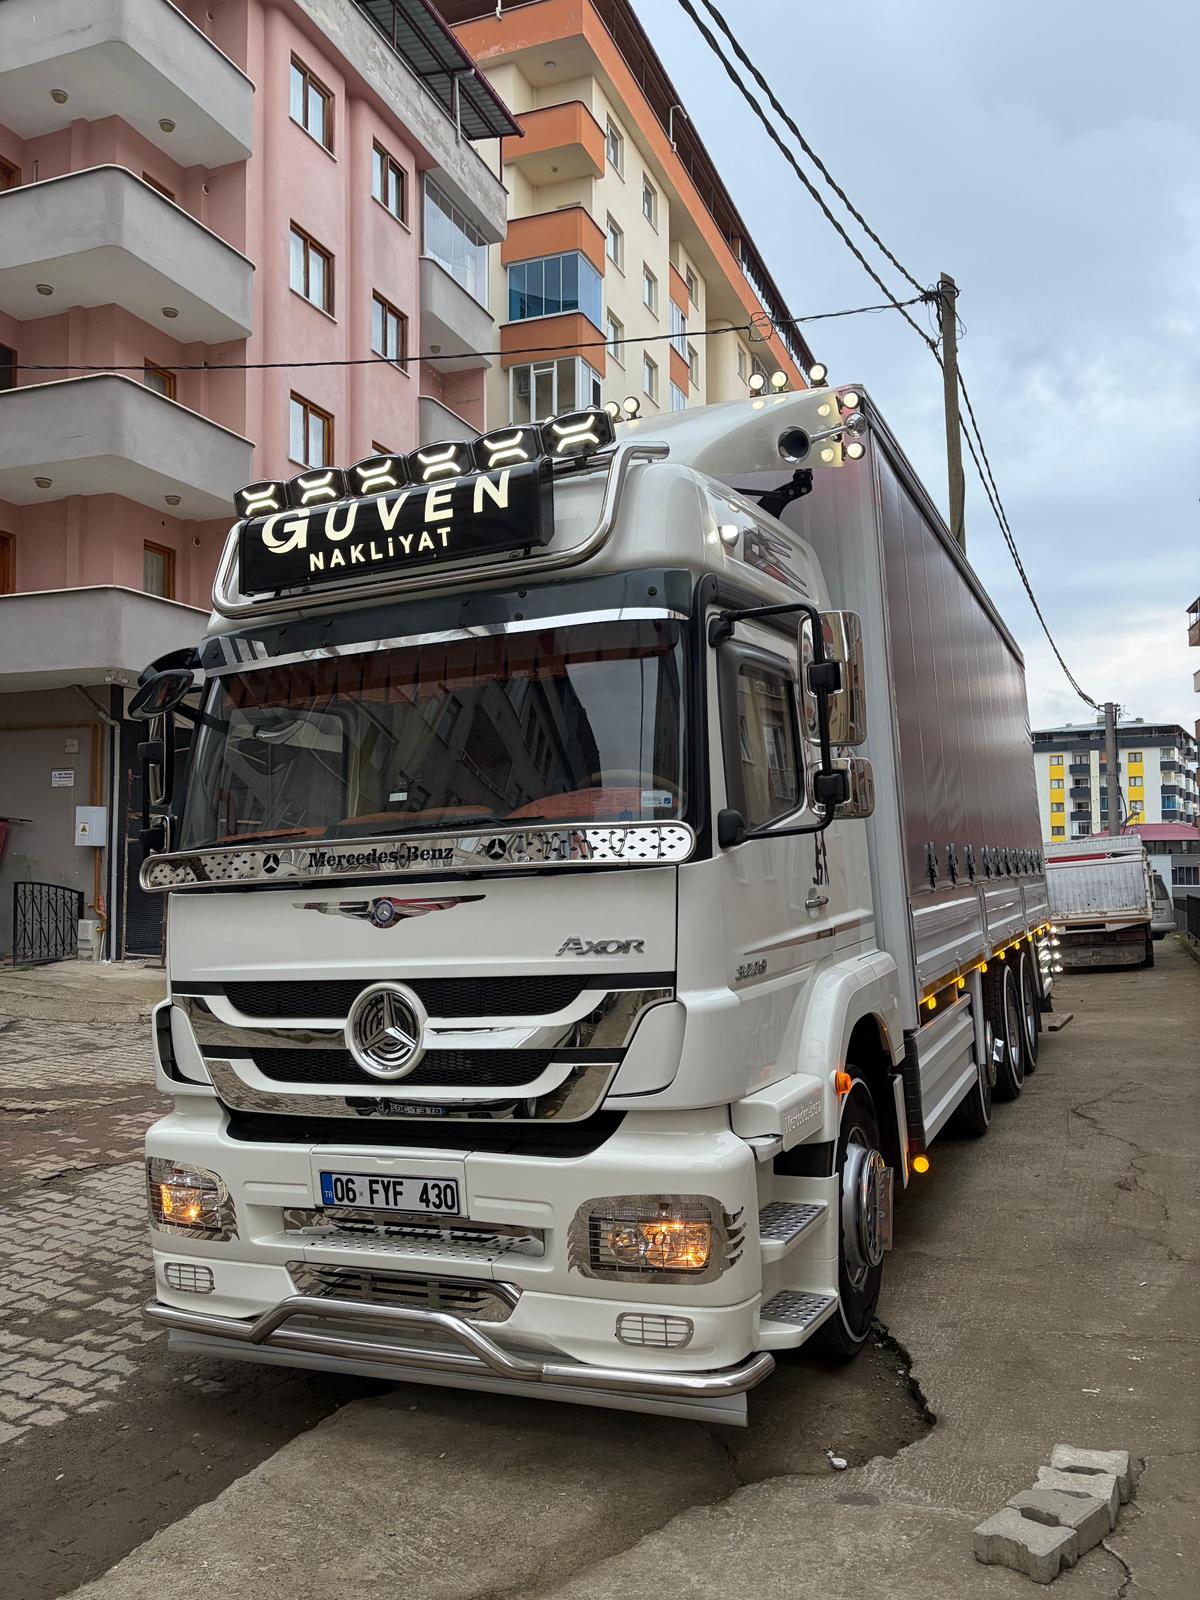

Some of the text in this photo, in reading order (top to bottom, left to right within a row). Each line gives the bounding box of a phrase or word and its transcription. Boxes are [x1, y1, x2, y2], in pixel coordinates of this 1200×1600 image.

[262, 471, 511, 553] GÜVEN
[309, 527, 452, 572] NAKLİYAT
[307, 845, 454, 868] Mercedes-Benz
[324, 1177, 456, 1210] TR 06 FYF 430
